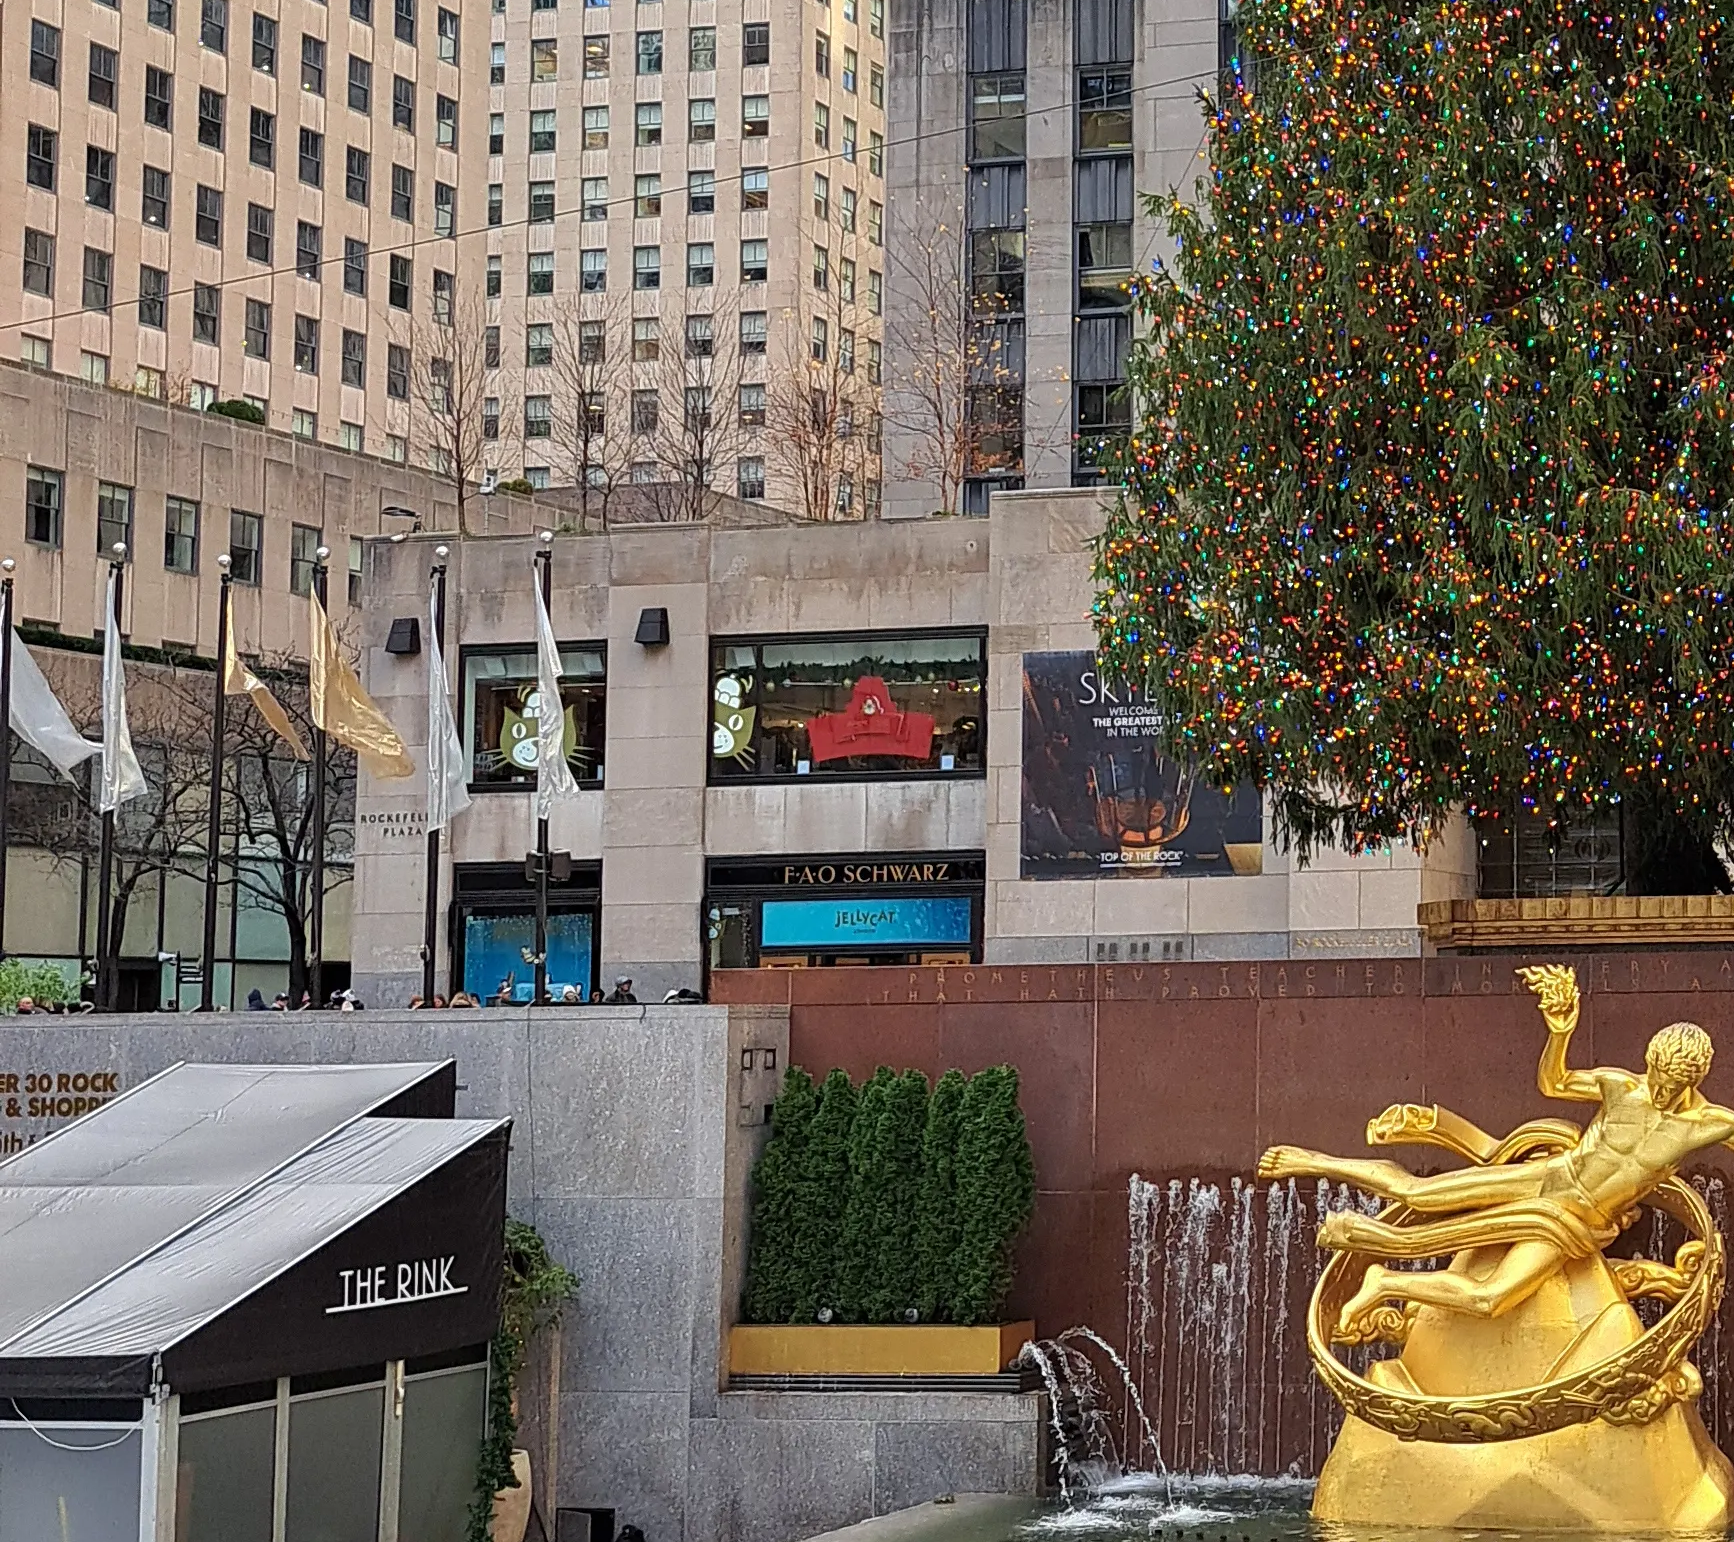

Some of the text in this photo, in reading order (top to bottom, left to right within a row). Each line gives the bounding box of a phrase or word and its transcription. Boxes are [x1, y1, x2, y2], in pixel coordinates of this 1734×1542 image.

[1092, 715, 1163, 728] THE GREATEST
[1106, 727, 1117, 737] IN
[1120, 726, 1138, 736] THE
[383, 826, 422, 837] PLAZA
[1101, 852, 1118, 862] TOP
[1120, 852, 1134, 862] OF
[1135, 851, 1152, 861] THE
[843, 864, 950, 883] SCHWARZ
[1455, 962, 1492, 976] IN
[882, 989, 973, 1002] THAT
[1020, 986, 1114, 1001] HATH
[1161, 984, 1317, 997] PROVED
[1690, 978, 1702, 991] A
[25, 1073, 53, 1093] 30
[57, 1072, 119, 1093] ROCK
[5, 1097, 22, 1117] &
[339, 1256, 455, 1308] THE RINK
